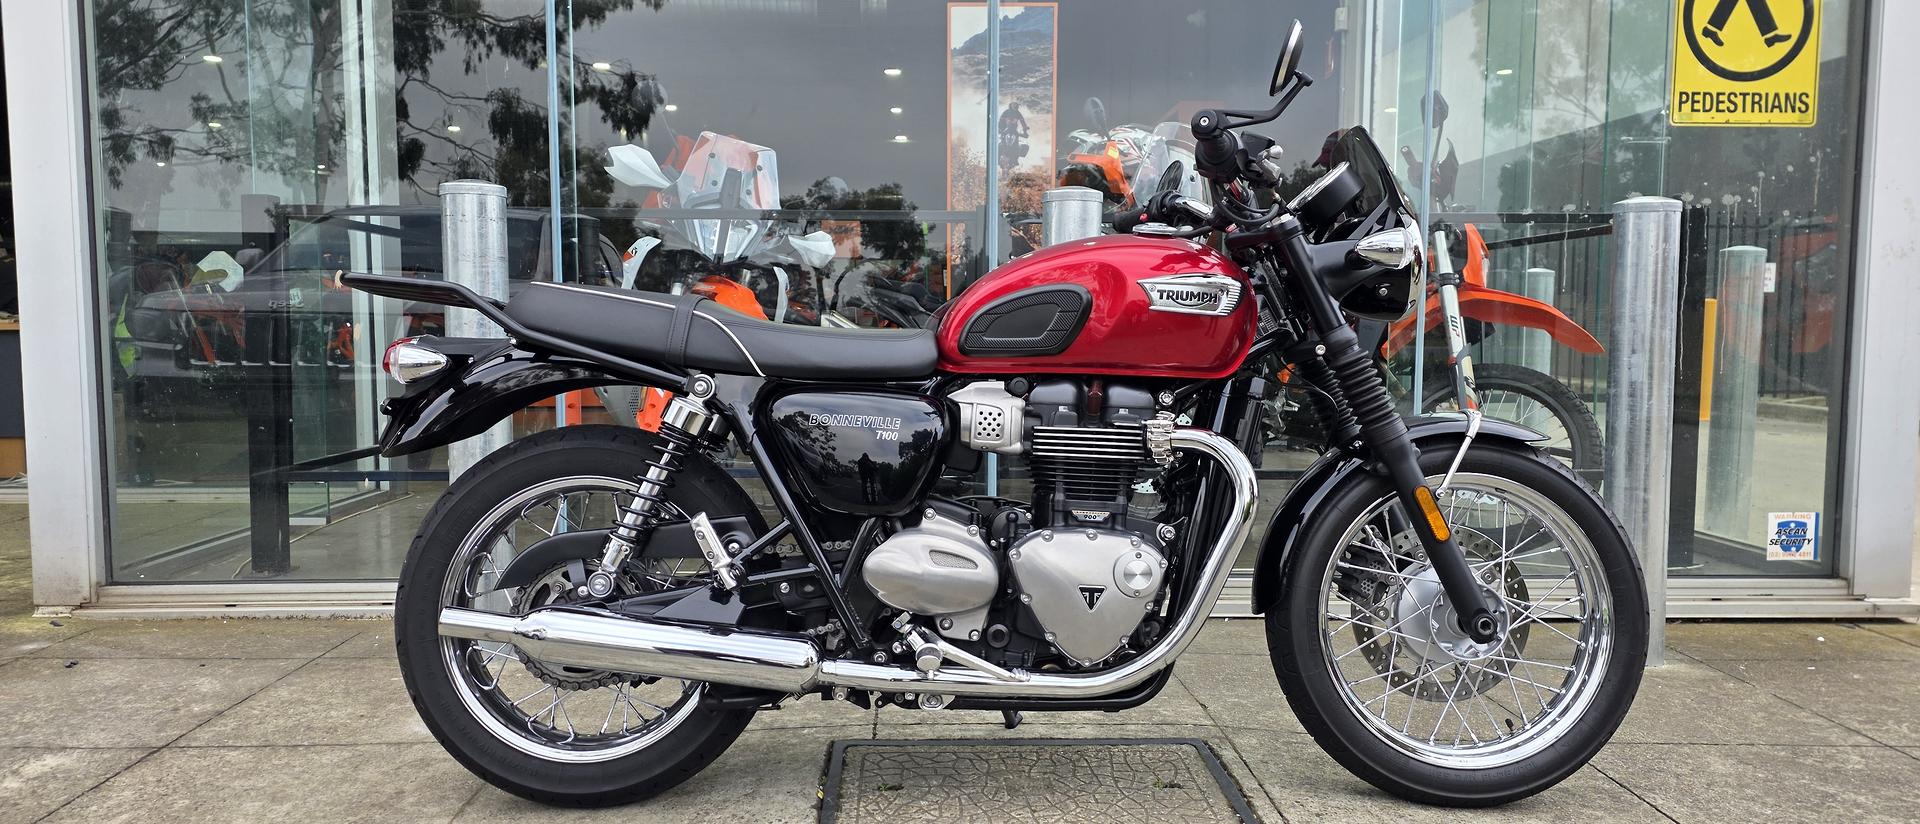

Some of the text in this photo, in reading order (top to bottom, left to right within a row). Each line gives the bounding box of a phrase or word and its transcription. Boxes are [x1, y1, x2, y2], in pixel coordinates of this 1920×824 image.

[1678, 91, 1809, 113] PEDESTRIANS
[1157, 289, 1218, 307] TRIUMPH
[809, 413, 901, 430] BONNEVILLE
[875, 430, 899, 441] T100
[1769, 538, 1813, 546] SECURITY
